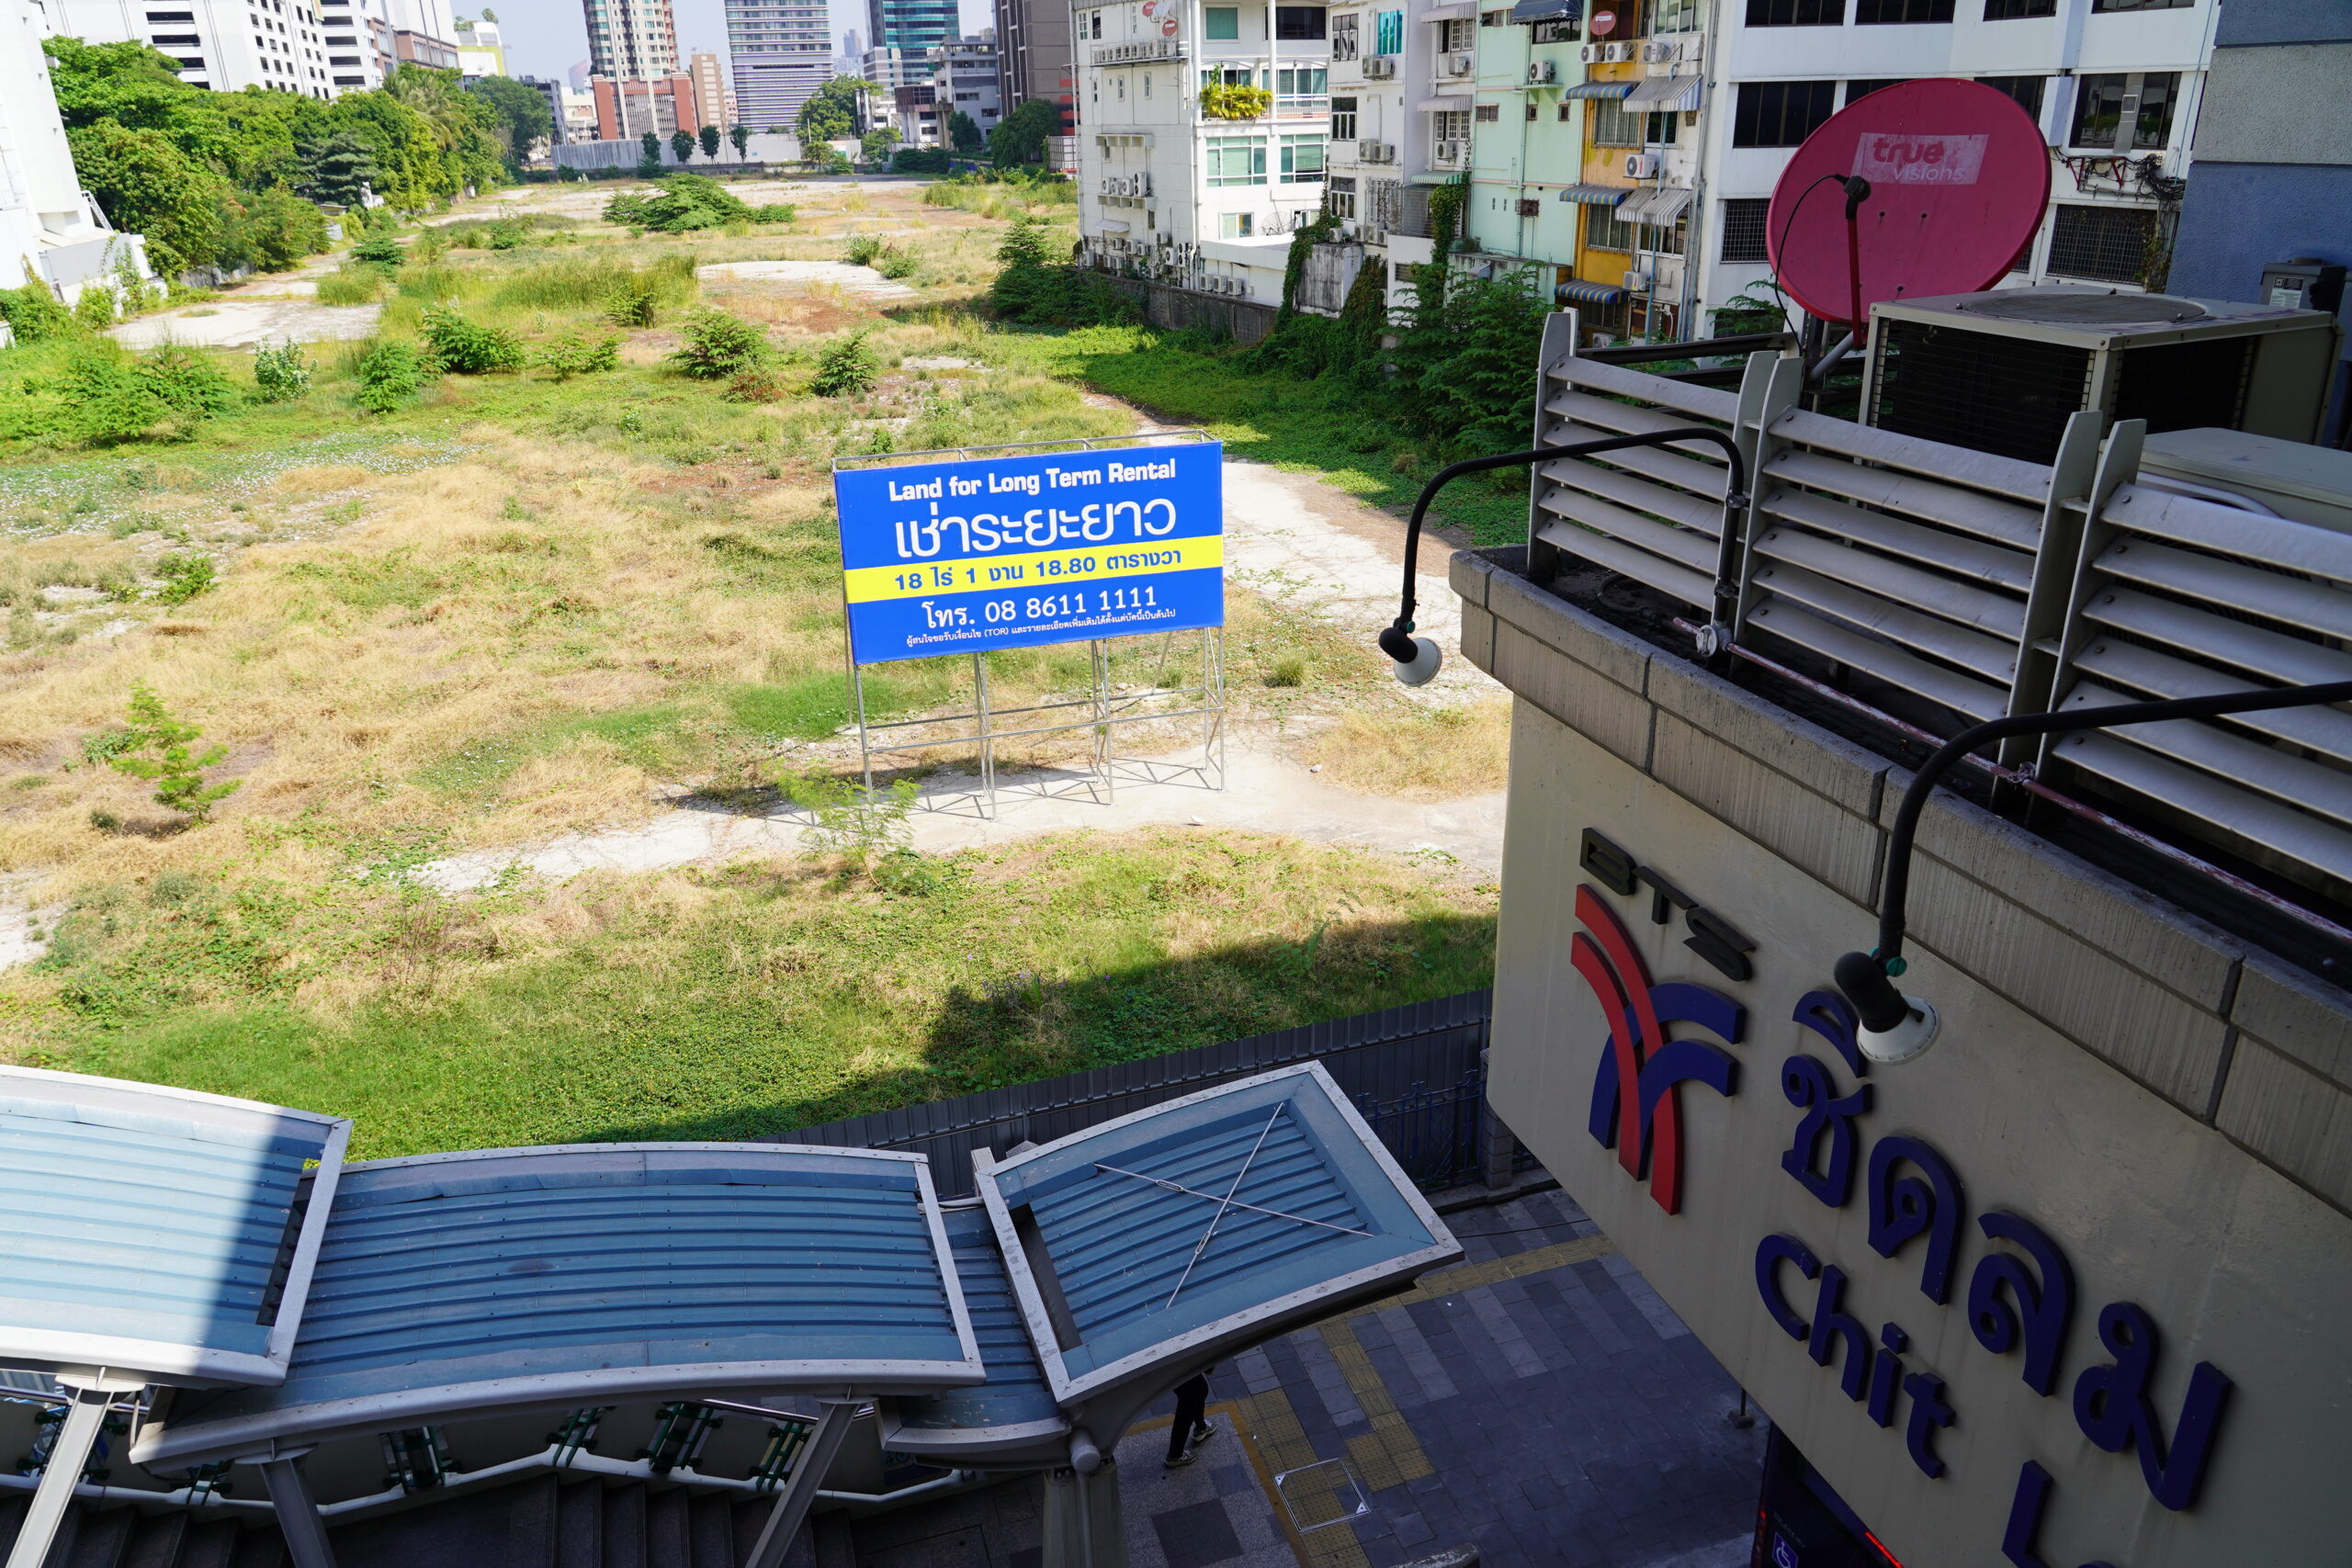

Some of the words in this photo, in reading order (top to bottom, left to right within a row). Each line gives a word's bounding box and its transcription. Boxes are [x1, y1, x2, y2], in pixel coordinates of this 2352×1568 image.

[1873, 138, 1944, 164] true
[1894, 165, 1964, 181] visions
[888, 477, 943, 502] Land
[948, 475, 982, 497] for
[989, 472, 1040, 496] Long
[1046, 468, 1102, 488] Term
[1108, 458, 1176, 483] Rental
[895, 498, 1177, 558] เช่าระยะยาว
[895, 573, 922, 591] 18
[930, 566, 953, 587] ไร่
[966, 568, 976, 583] 1
[989, 565, 1023, 581] งาน
[1035, 557, 1096, 578] 18.80
[1106, 549, 1182, 570] ตารางวา
[922, 601, 976, 628] โทร.
[985, 600, 1017, 623] 08
[1026, 592, 1087, 619] 8611
[1099, 586, 1157, 611] 1111
[984, 627, 1009, 637] (TOR)
[1579, 827, 1757, 982] BTS
[1756, 1234, 1956, 1479] Chit
